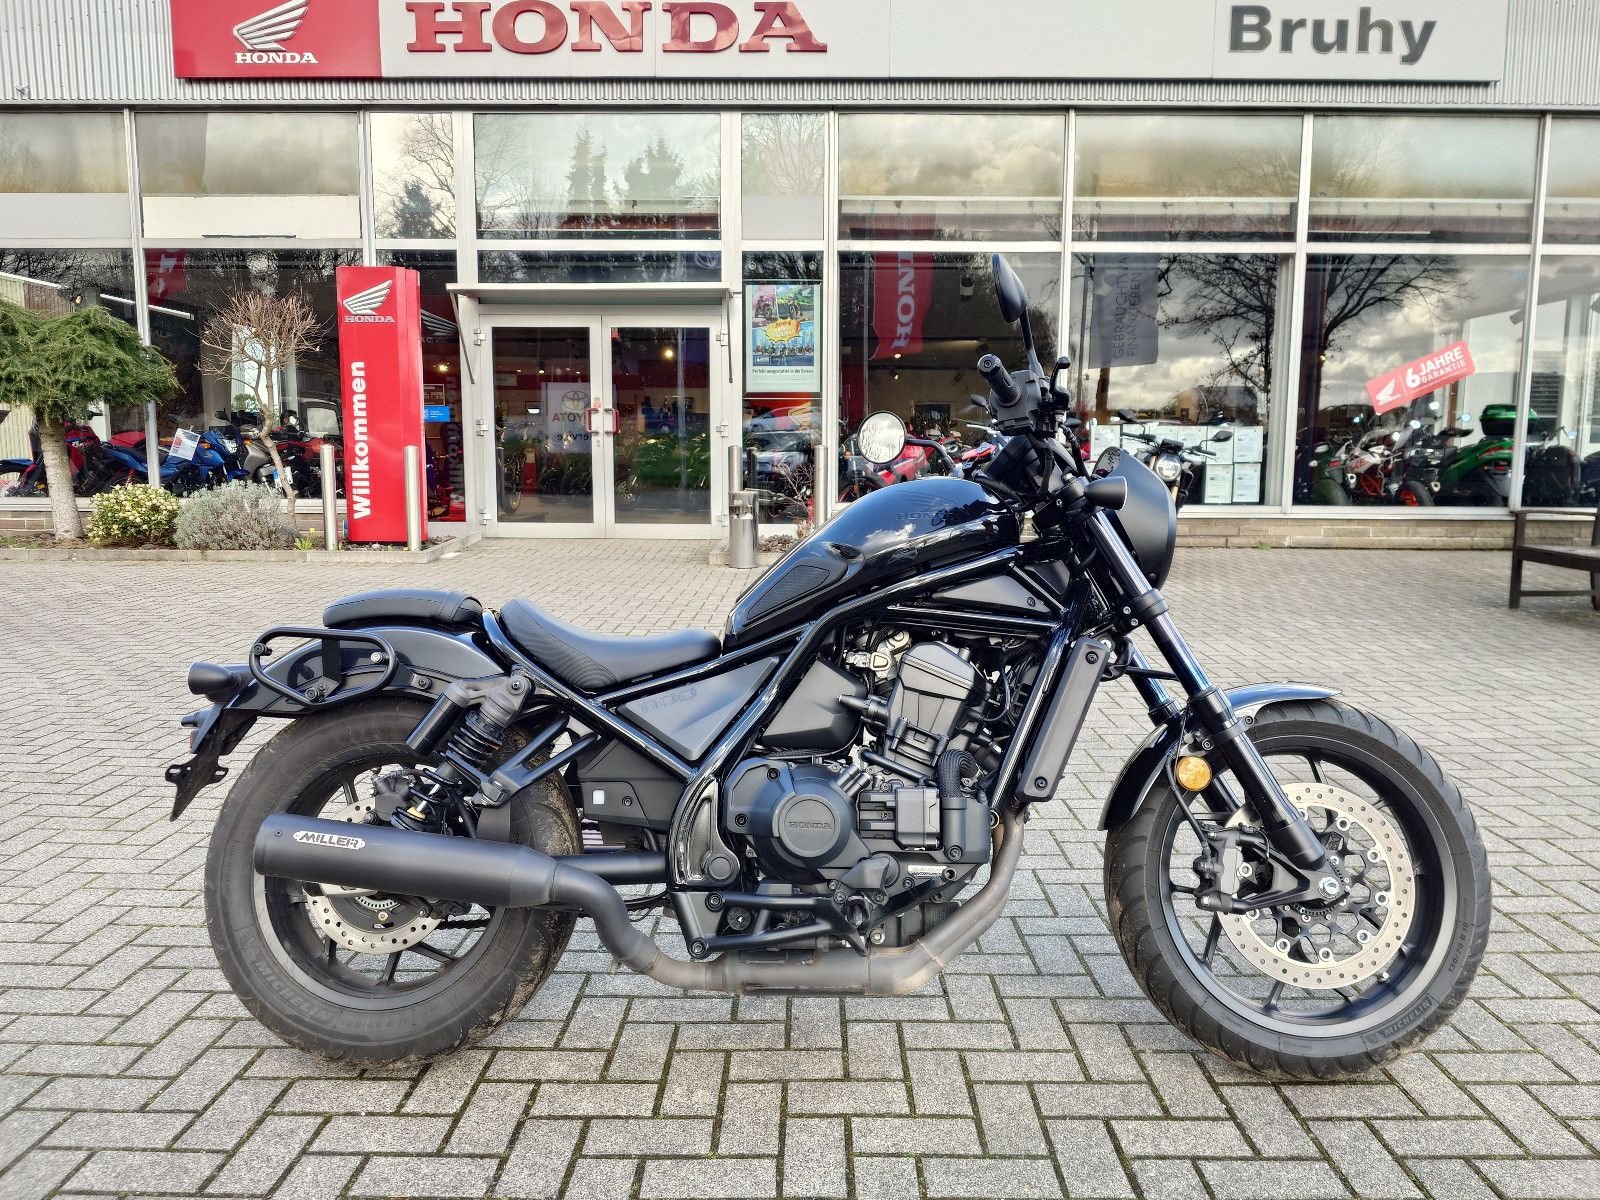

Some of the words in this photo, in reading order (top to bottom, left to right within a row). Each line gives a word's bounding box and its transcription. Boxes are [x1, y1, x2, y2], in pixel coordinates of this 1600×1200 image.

[405, 0, 828, 54] HONDA
[1228, 5, 1438, 65] Bruhy
[234, 52, 318, 64] HONDA
[344, 315, 395, 323] HONDA
[1406, 367, 1421, 389] 6
[1420, 347, 1464, 376] JAHRE
[1422, 359, 1466, 384] GARANTIE
[351, 361, 371, 520] Willkommen
[300, 832, 359, 848] MILLER
[788, 821, 832, 830] HONDA
[253, 960, 335, 1026] MICHELIN
[1384, 995, 1434, 1036] MICHELIN
